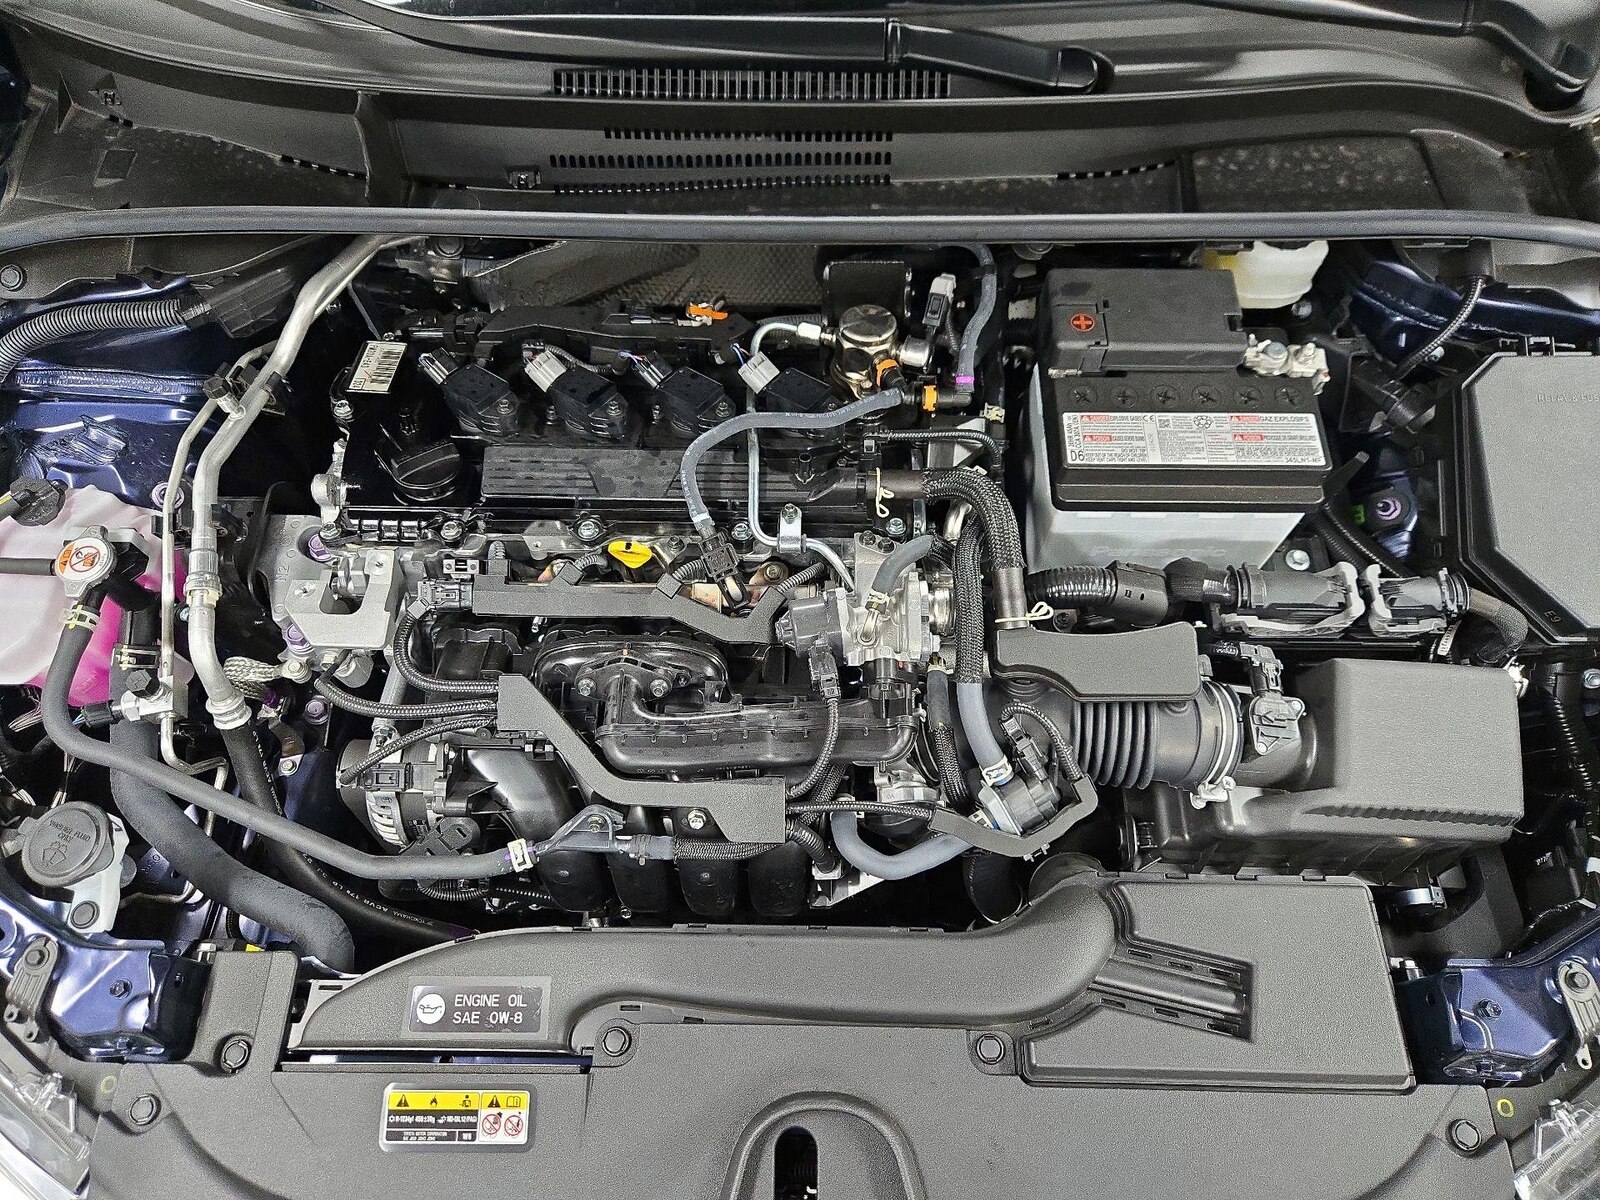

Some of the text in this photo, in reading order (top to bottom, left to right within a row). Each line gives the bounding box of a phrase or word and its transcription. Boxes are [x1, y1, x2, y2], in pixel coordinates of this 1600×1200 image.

[1070, 450, 1085, 461] D6
[454, 994, 528, 1007] ENGINE OIL
[452, 1011, 523, 1024] SAE 0W-8
